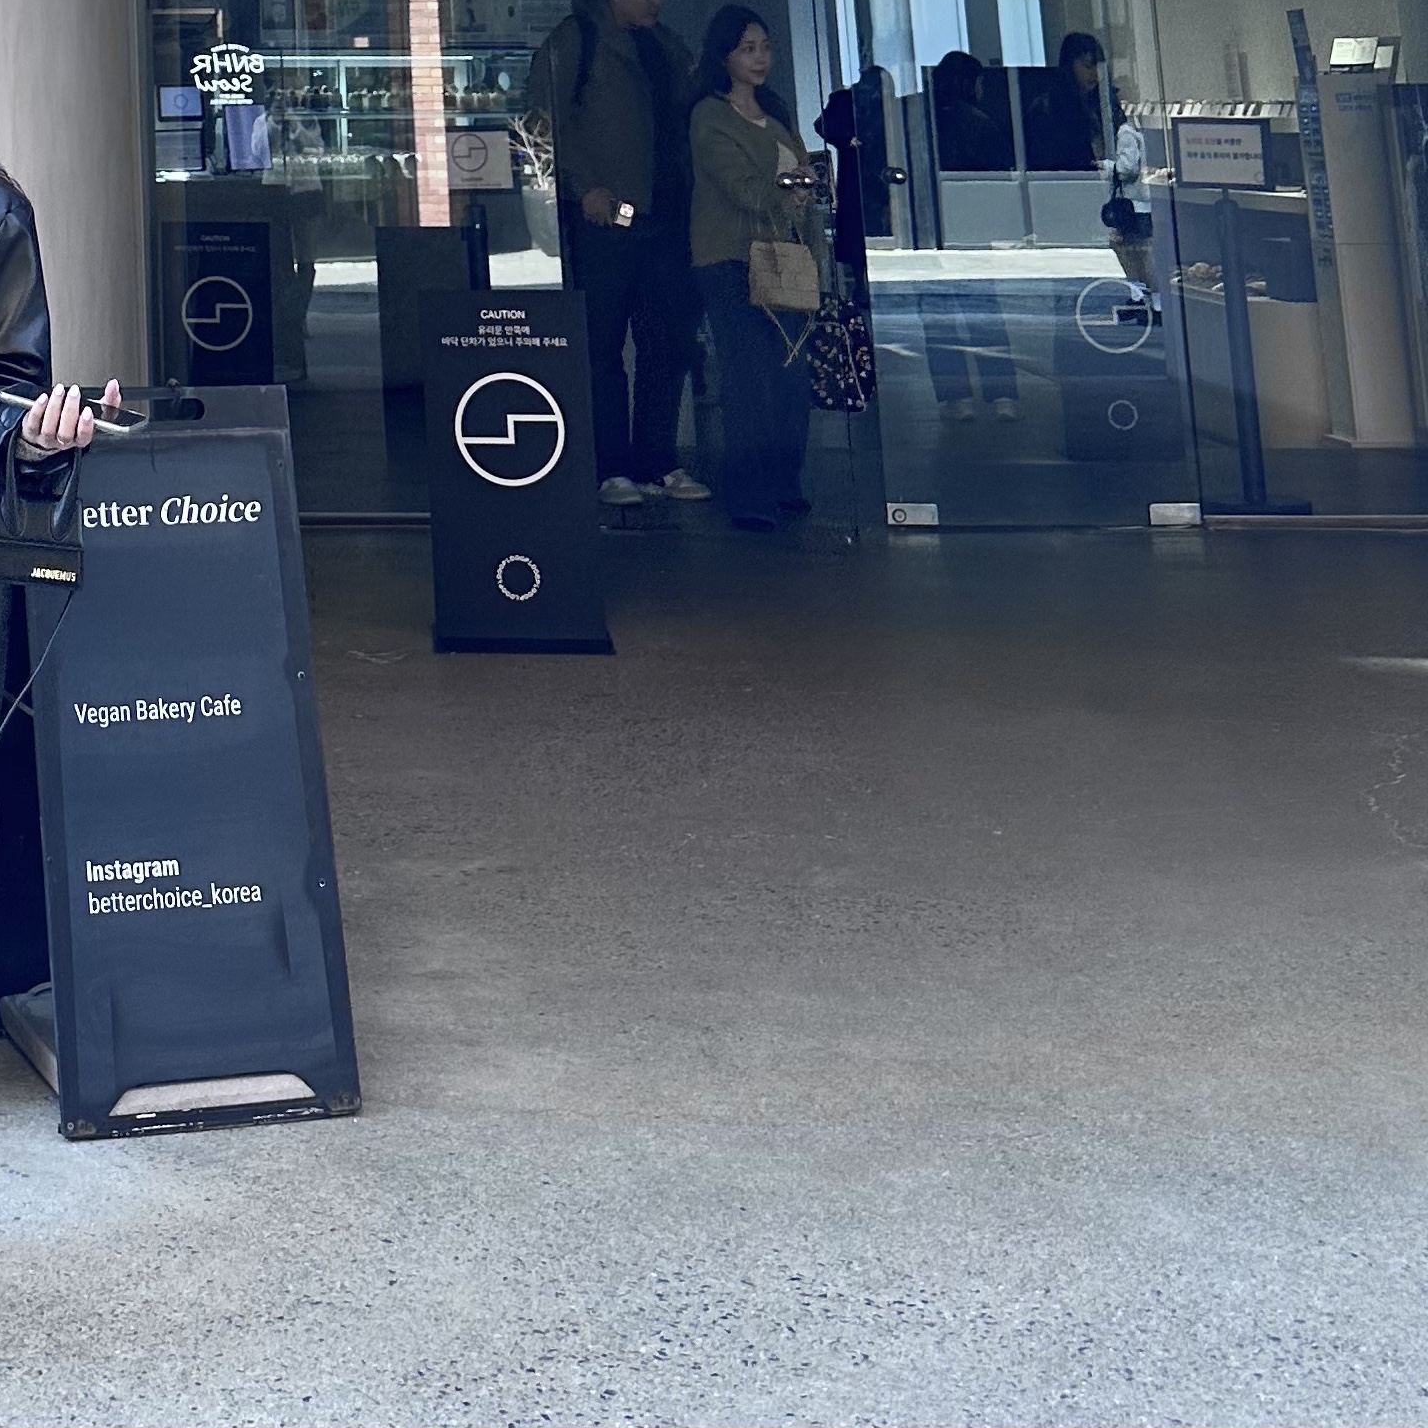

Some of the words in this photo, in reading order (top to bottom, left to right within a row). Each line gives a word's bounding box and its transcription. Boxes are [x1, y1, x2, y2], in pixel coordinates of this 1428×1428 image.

[480, 309, 526, 320] CAUTION
[460, 336, 486, 347] 단차가
[487, 336, 513, 347] 있으니
[515, 336, 541, 347] 주의해
[542, 336, 568, 347] 주세요
[83, 502, 154, 528] etter
[160, 494, 262, 525] Choice
[74, 702, 131, 727] Vegan
[135, 697, 196, 722] Bakery
[200, 693, 242, 717] Cafe
[86, 857, 180, 886] Instagram
[87, 882, 262, 915] betterchoice_korea
